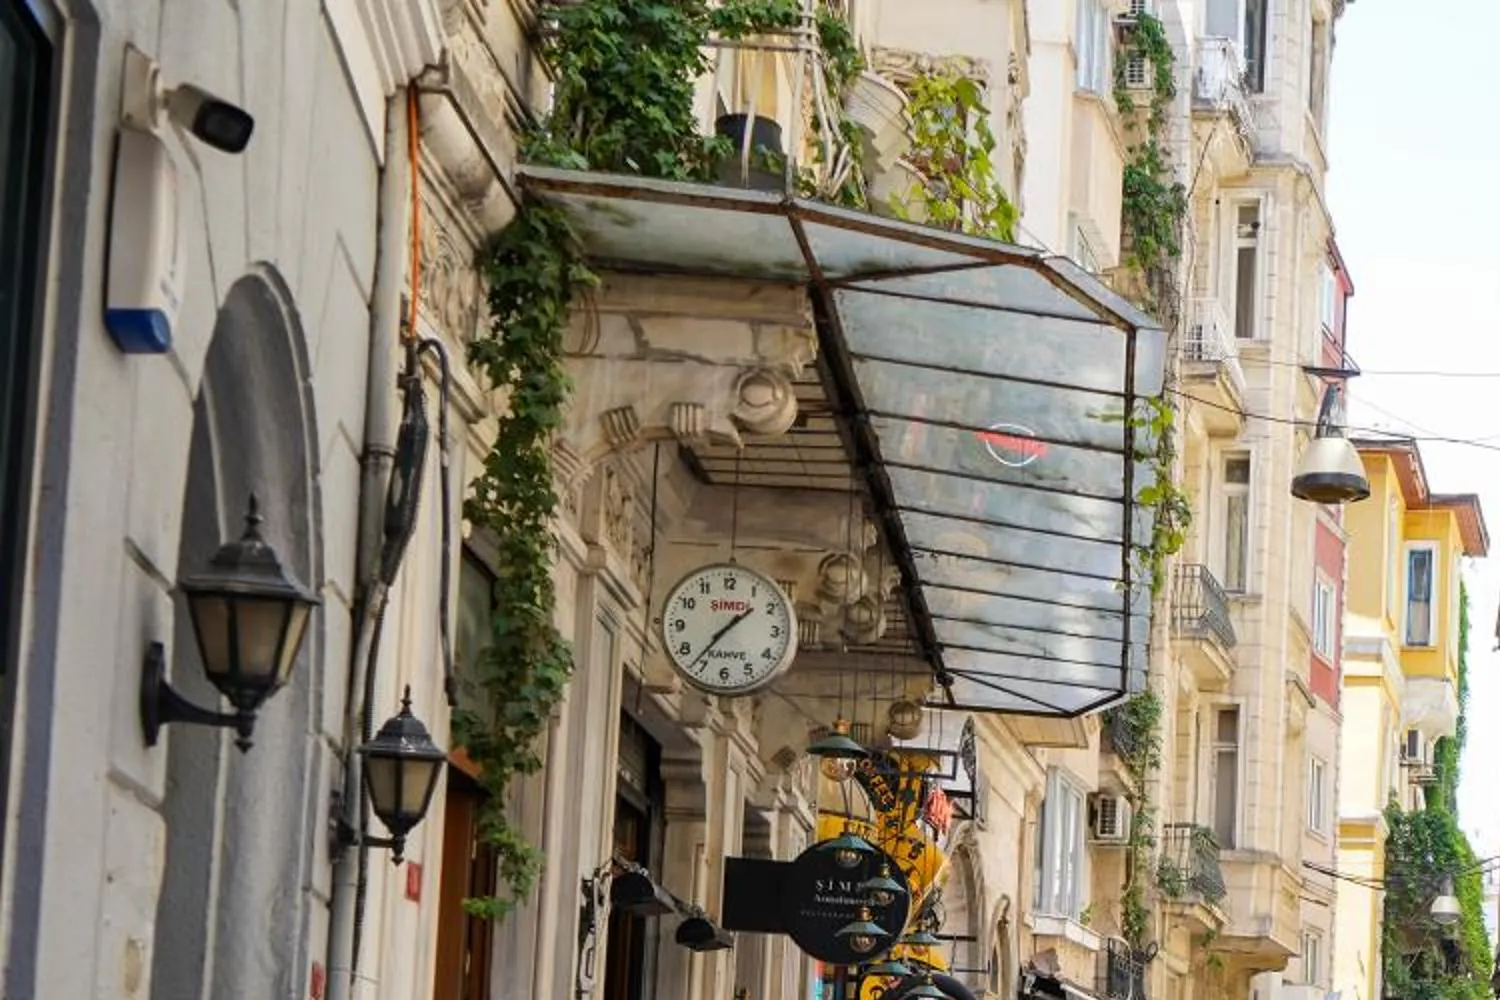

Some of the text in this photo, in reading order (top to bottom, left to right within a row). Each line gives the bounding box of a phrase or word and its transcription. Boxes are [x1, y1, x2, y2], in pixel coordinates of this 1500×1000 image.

[699, 581, 711, 594] 11
[723, 578, 737, 591] 12
[751, 585, 757, 598] 1
[681, 597, 696, 610] 10
[766, 602, 775, 615] 2
[675, 619, 685, 632] 9
[770, 625, 780, 638] 3
[680, 642, 691, 655] 8
[707, 649, 747, 661] KAHVE
[761, 647, 771, 660] 4
[699, 660, 708, 673] 7
[743, 663, 753, 676] 5
[719, 667, 729, 680] 6
